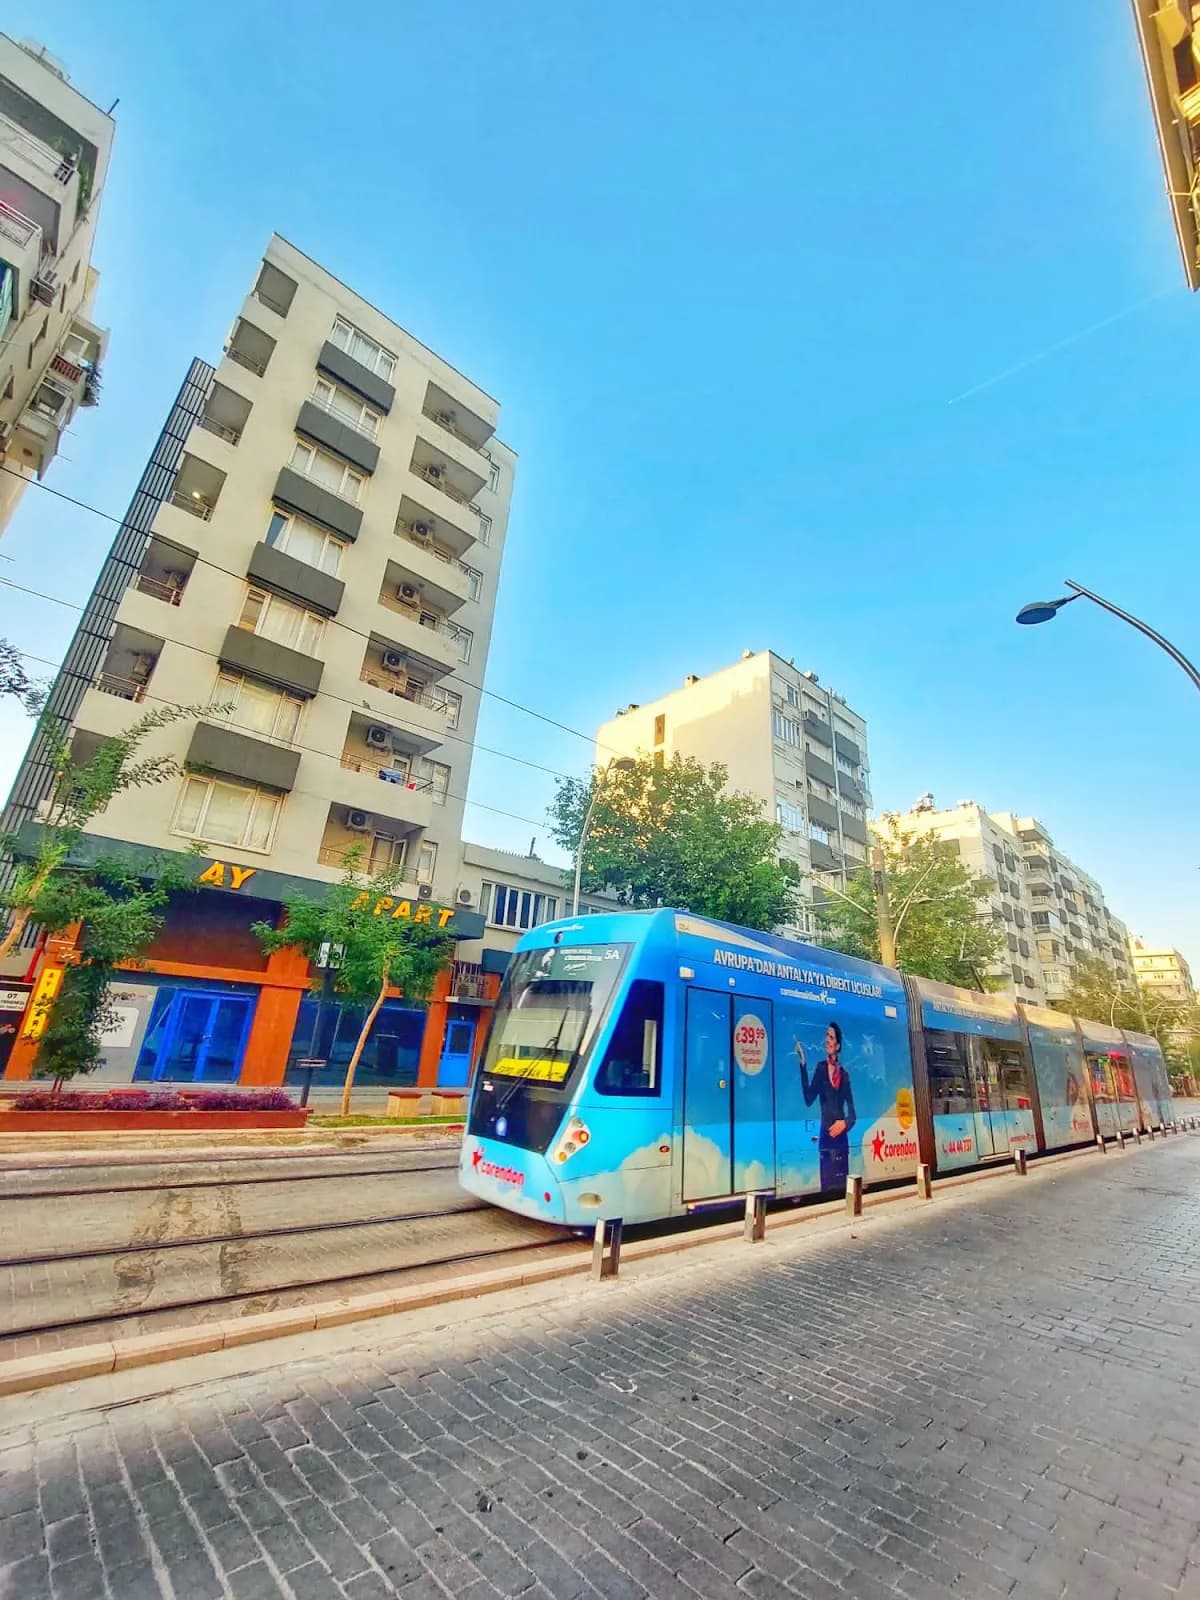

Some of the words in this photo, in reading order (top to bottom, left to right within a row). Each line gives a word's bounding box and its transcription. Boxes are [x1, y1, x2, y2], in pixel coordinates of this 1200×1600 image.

[199, 860, 257, 890] AY
[350, 891, 456, 929] APART
[604, 949, 620, 960] 5A
[714, 949, 776, 976] AVRUPA'DAN
[776, 963, 826, 988] ANTALYA'YA
[884, 1138, 917, 1158] corendon
[481, 1161, 525, 1185] corendon
